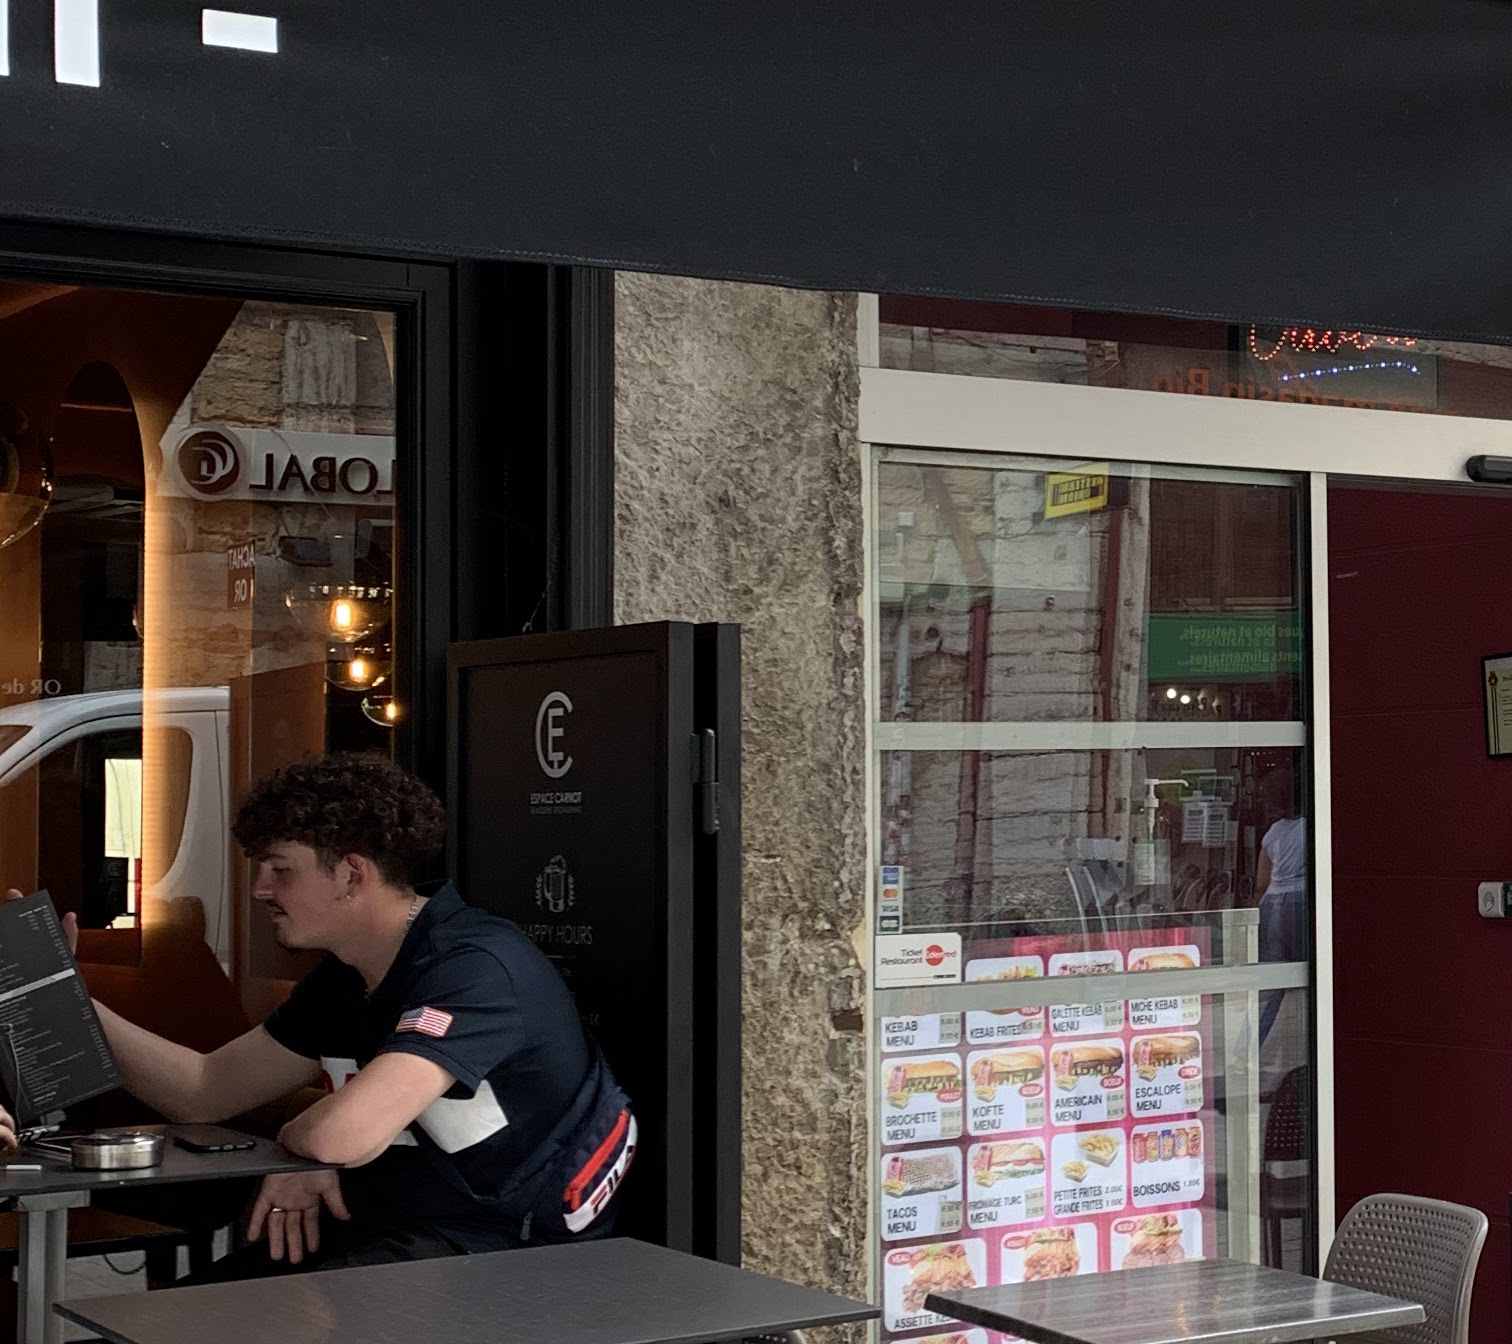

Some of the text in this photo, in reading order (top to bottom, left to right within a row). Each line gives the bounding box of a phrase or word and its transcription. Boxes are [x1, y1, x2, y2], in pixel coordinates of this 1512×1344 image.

[1082, 1004, 1102, 1017] KEBAB
[1154, 998, 1178, 1010] KEBAB
[1053, 1020, 1080, 1032] MENU
[1132, 1014, 1157, 1025] MENU
[885, 1020, 918, 1034] KEBAB
[970, 1027, 994, 1039] KEBAB
[887, 1034, 915, 1047] MENU
[1135, 1083, 1181, 1099] ESCALOPE
[1055, 1094, 1103, 1109] AMERICAIN
[1136, 1099, 1162, 1112] MENU
[972, 1104, 1004, 1118] KOFTE
[1055, 1109, 1082, 1122] MENU
[886, 1111, 937, 1127] BROCHETTE
[973, 1118, 1001, 1132] MENU
[887, 1128, 916, 1141] MENU
[1054, 1188, 1077, 1201] PETITE
[1078, 1186, 1102, 1199] FRITES
[1133, 1181, 1181, 1197] BOISSONS
[887, 1206, 918, 1220] TACOS
[1054, 1202, 1080, 1215] GRANDE
[1081, 1199, 1103, 1212] FRITES
[970, 1211, 998, 1224] MENU
[887, 1221, 917, 1234] MENU
[894, 1314, 933, 1330] ASSIETTE
